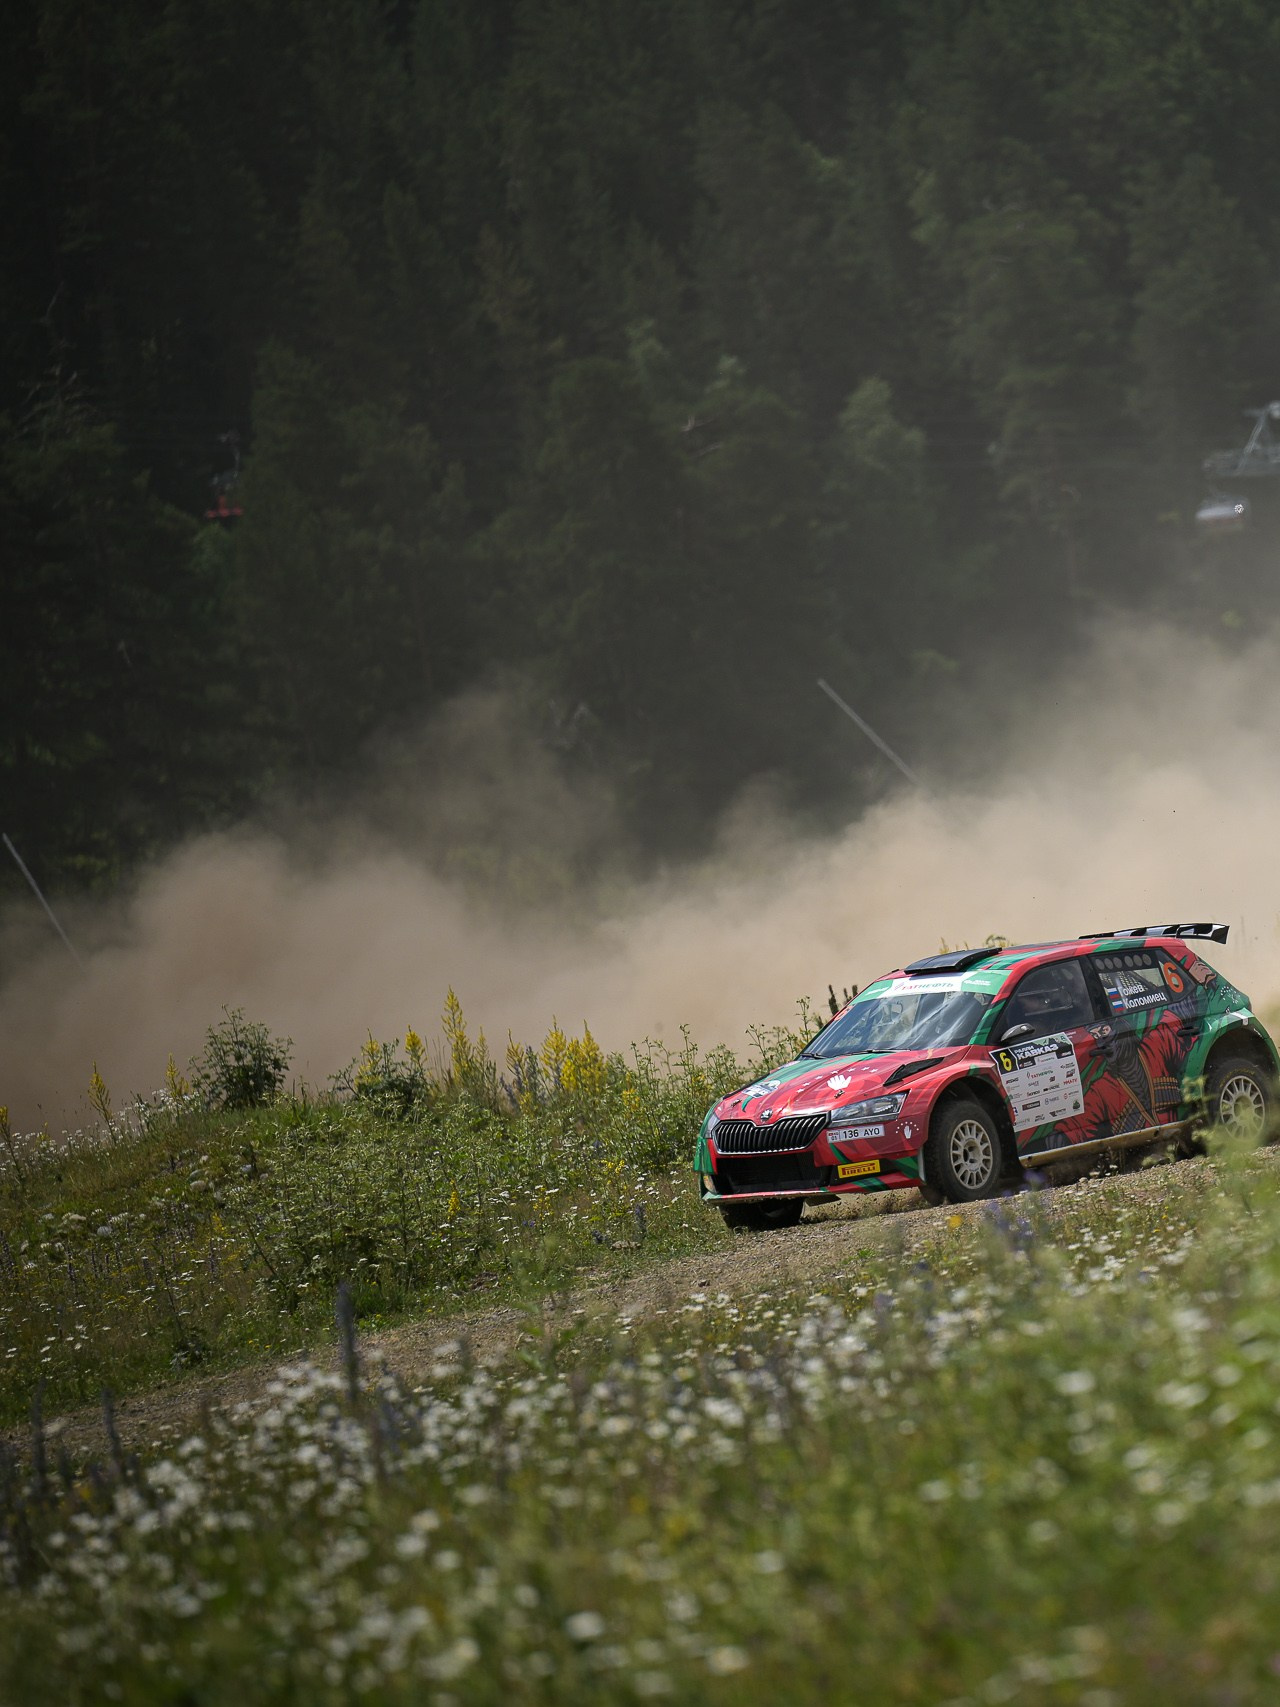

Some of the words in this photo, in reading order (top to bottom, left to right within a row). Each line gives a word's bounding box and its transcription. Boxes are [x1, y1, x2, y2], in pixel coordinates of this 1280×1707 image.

[1163, 962, 1184, 993] 6
[1124, 994, 1168, 1009] Коломиец
[1017, 1045, 1058, 1060] КАВКАЗ
[1000, 1052, 1012, 1072] 6
[843, 1130, 859, 1139] 136
[864, 1128, 880, 1137] AYO
[841, 1163, 876, 1175] PIRELLI
